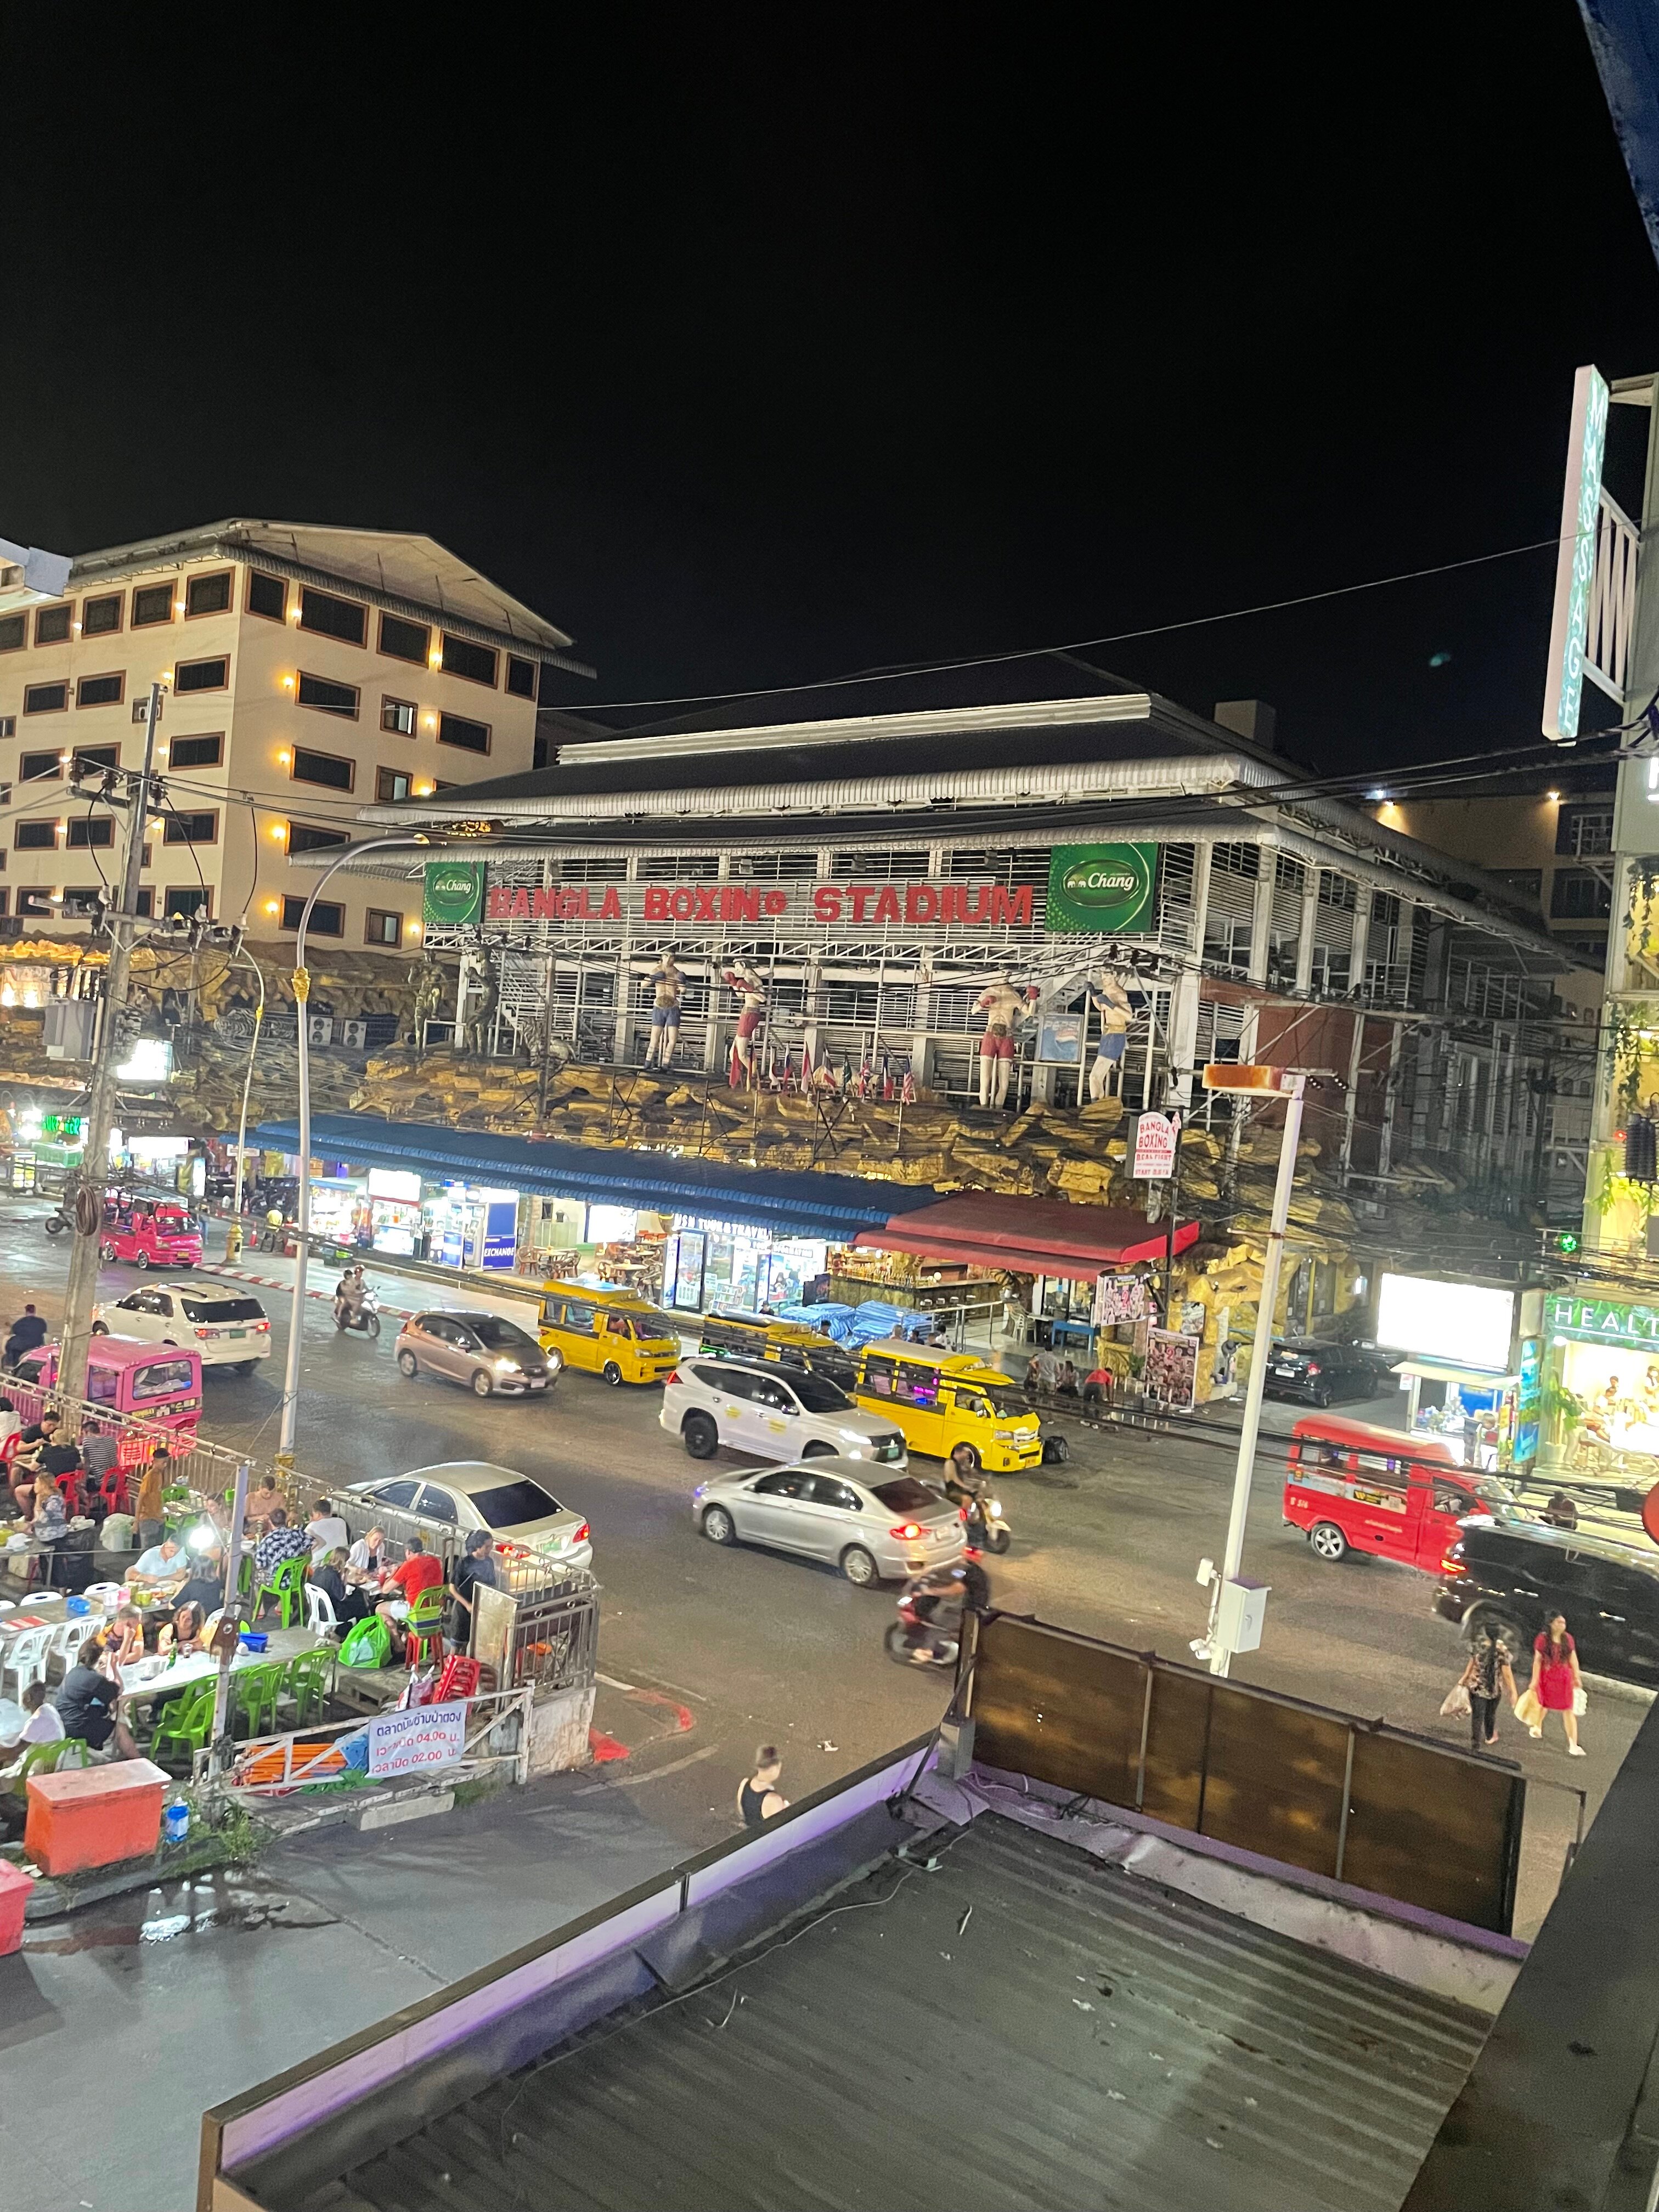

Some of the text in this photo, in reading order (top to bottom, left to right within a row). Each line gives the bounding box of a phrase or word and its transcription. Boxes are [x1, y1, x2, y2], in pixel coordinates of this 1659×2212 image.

[1564, 380, 1606, 731] MASSAGE
[446, 879, 472, 894] Chang
[1088, 873, 1135, 891] Chang
[489, 886, 621, 919] BANGLA
[814, 885, 1034, 926] STADIUM
[1140, 1121, 1169, 1135] BANGLA
[1138, 1133, 1168, 1148] BOXING
[484, 1247, 515, 1257] EXCHANGE
[417, 1731, 447, 1743] 04.00
[412, 1750, 443, 1764] 02.00
